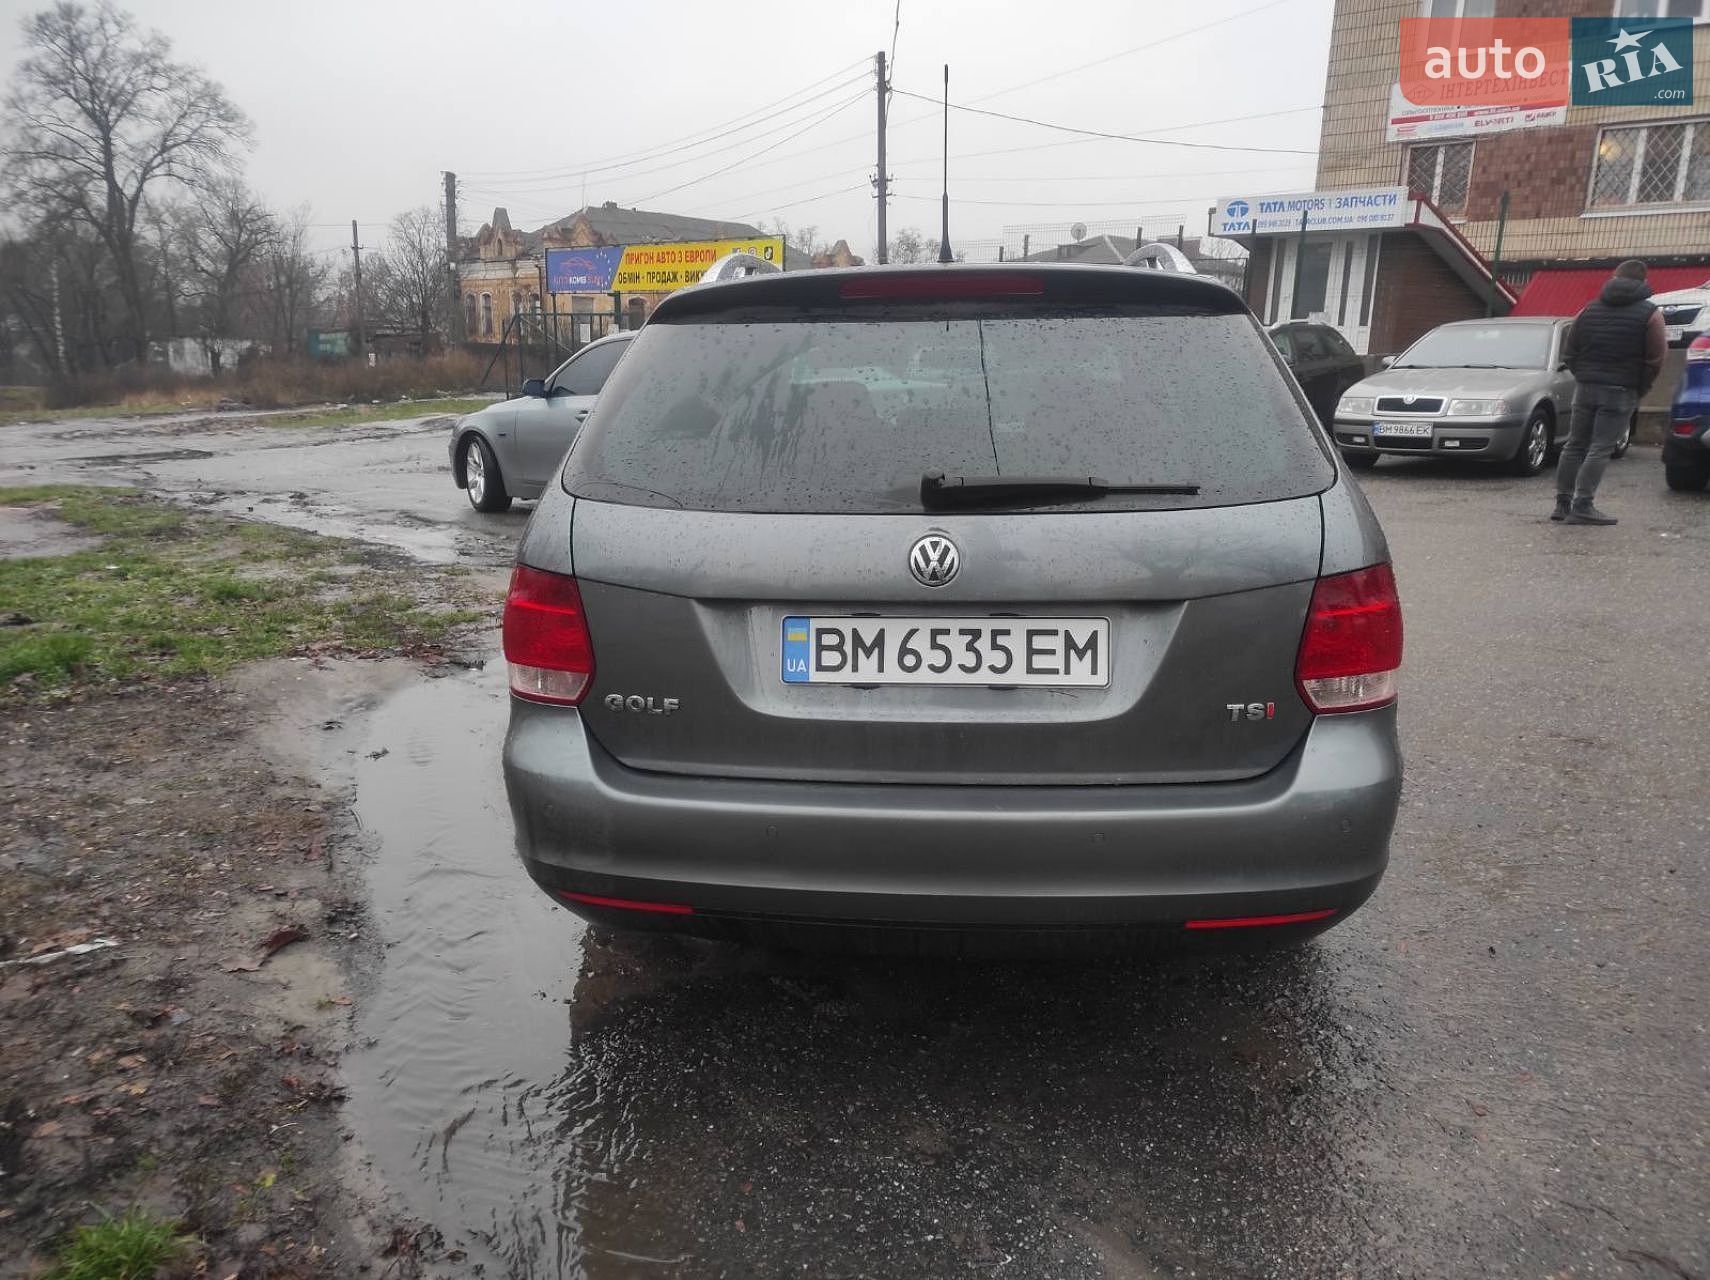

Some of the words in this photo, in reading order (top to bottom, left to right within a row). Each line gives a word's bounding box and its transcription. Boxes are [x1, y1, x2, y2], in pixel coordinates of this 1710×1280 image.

[1259, 201, 1285, 213] TATA
[1287, 198, 1325, 211] MOTORS
[1335, 193, 1397, 209] ЗАПЧАСТИ
[1221, 220, 1250, 232] TATA
[625, 251, 654, 265] ПРИГОН
[656, 251, 676, 264] АВТО
[618, 271, 640, 284] ОБМІН
[647, 271, 679, 284] ПРОДАЖ
[815, 627, 886, 673] BM
[897, 628, 1013, 674] 6535
[1026, 629, 1099, 675] EM
[786, 658, 807, 673] UA
[604, 693, 680, 716] GOLF
[1226, 702, 1275, 721] TSI
